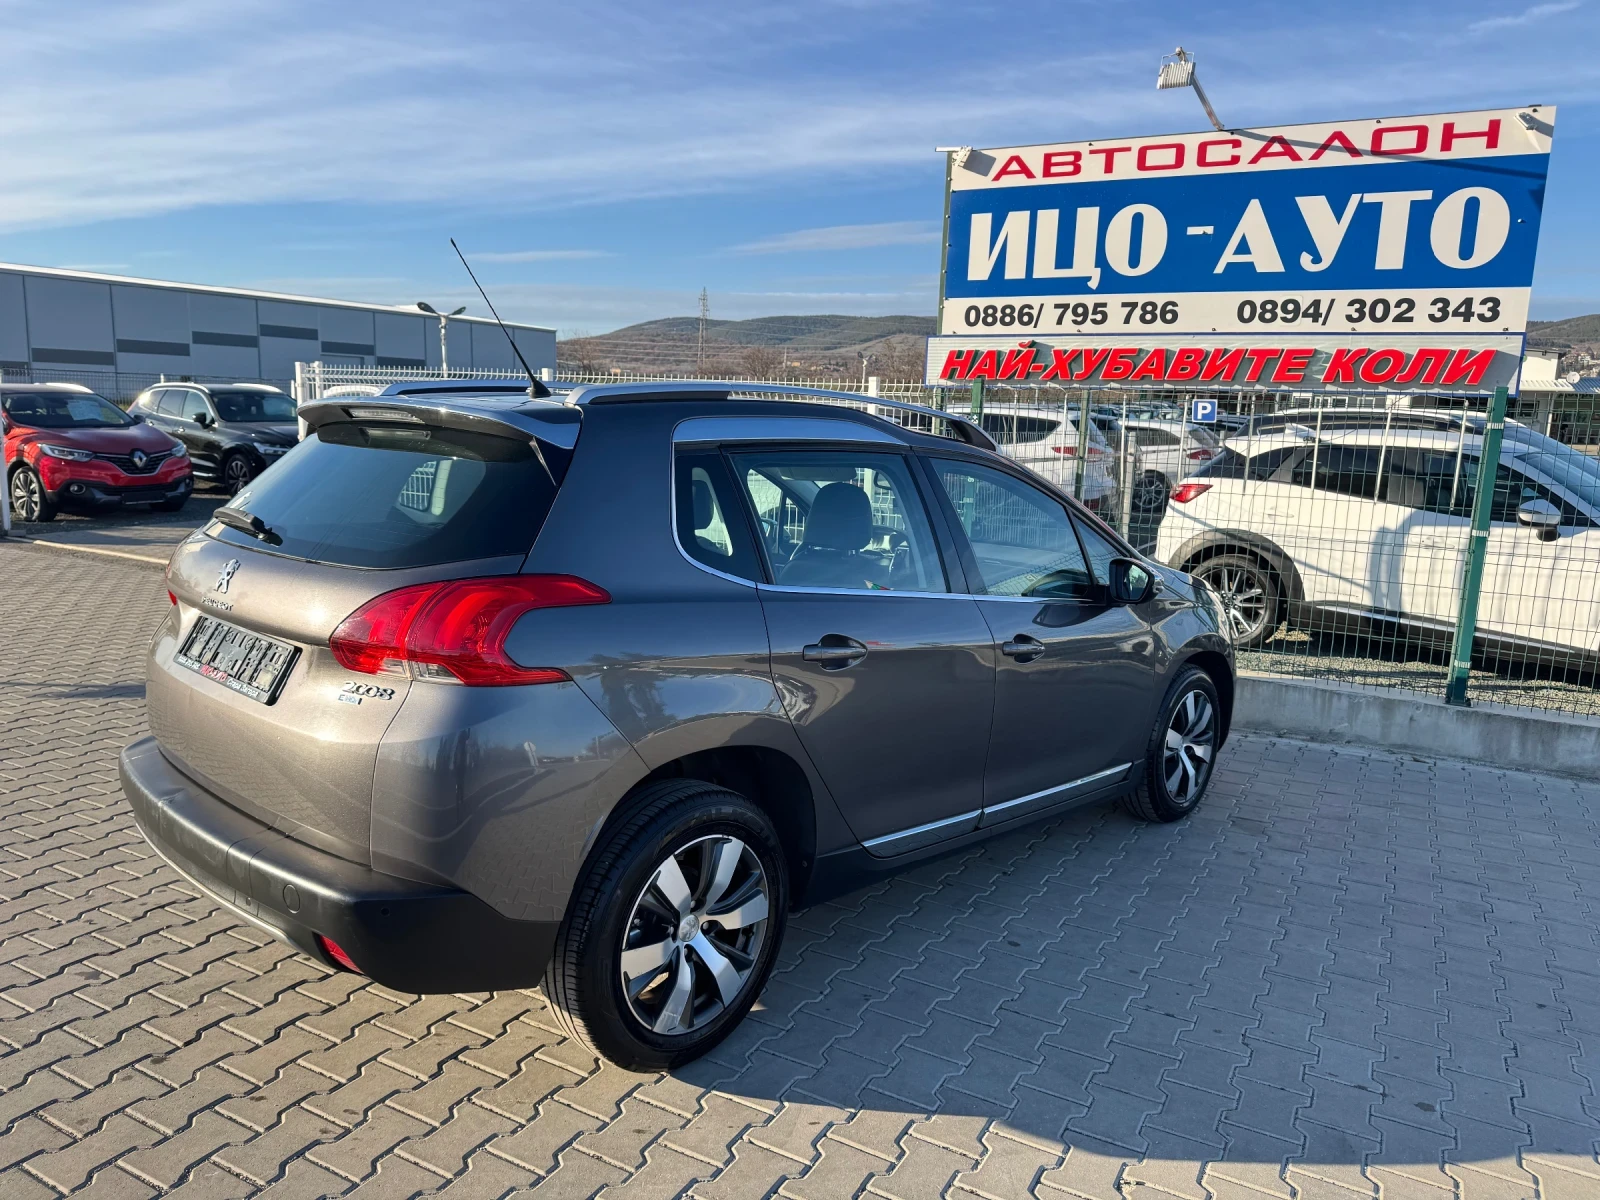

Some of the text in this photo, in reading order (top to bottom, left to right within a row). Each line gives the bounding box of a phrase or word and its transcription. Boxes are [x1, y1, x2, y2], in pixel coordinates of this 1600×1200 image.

[991, 118, 1502, 183] АВТОСАЛОН
[964, 301, 1180, 329] 0886/ 795 786
[1237, 296, 1502, 327] 0894/ 302 343
[939, 340, 1498, 387] НАЙ-ХУБАВИТЕ КОЛИ
[1197, 402, 1212, 420] P
[342, 680, 396, 701] 2008
